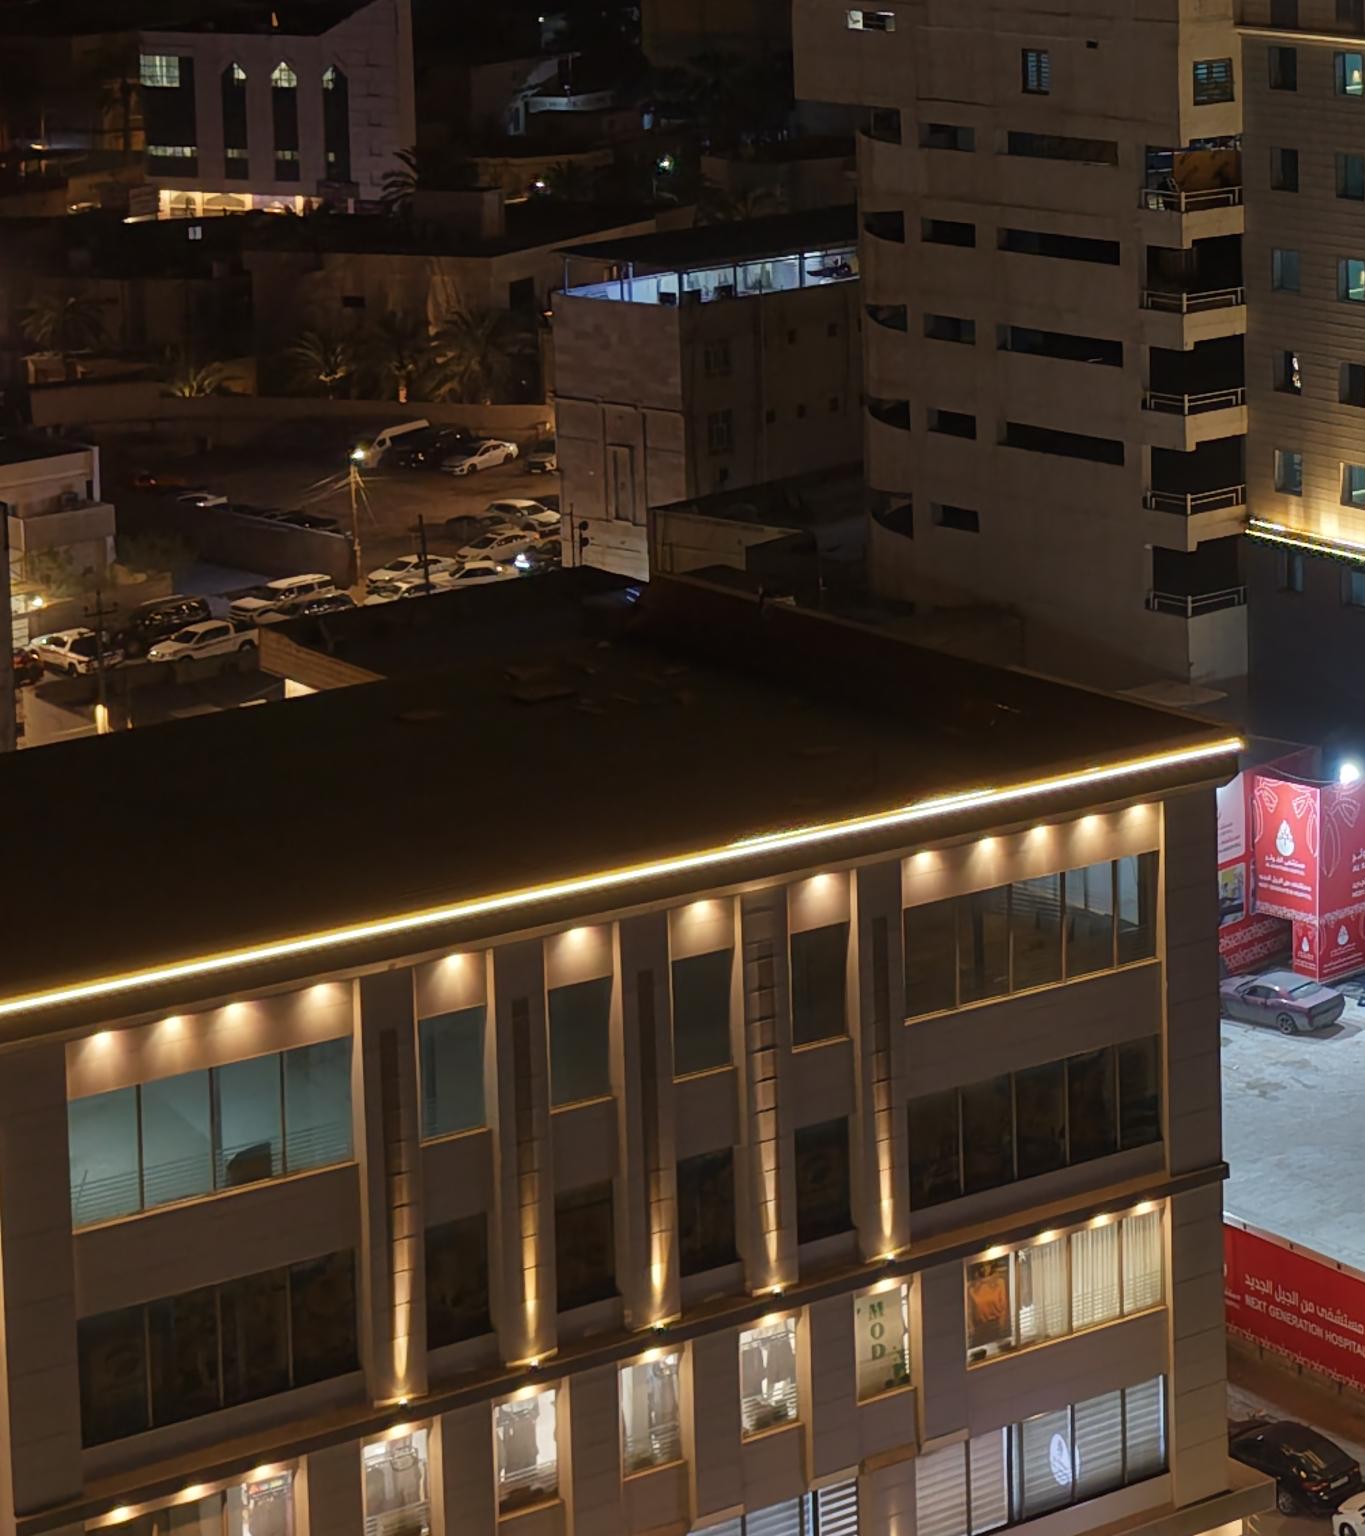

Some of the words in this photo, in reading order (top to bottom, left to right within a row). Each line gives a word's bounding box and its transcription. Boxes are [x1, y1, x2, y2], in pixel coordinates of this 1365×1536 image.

[1244, 1273, 1273, 1295] الجديد
[1274, 1284, 1299, 1306] الجيل
[1244, 1294, 1267, 1313] NEXT
[1268, 1305, 1323, 1339] GENERATION
[1300, 1298, 1315, 1314] من
[1316, 1305, 1365, 1335] مستشفى
